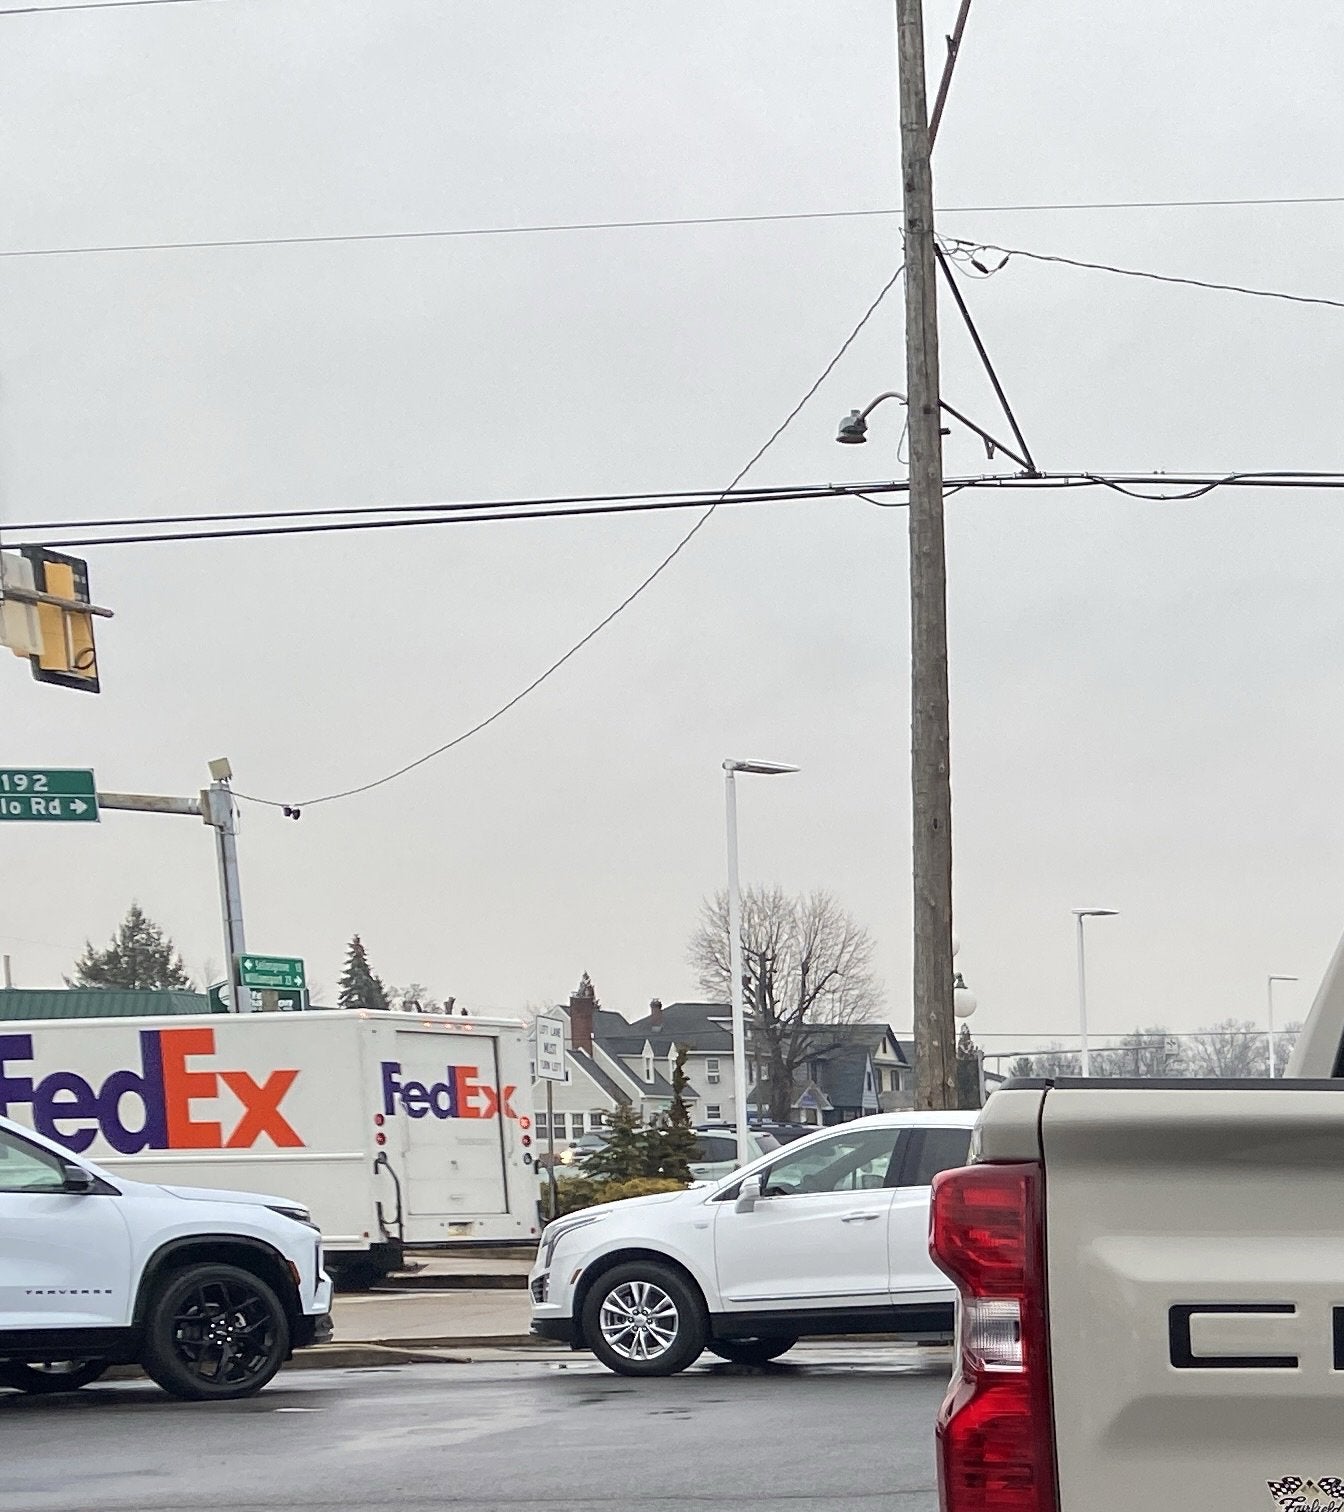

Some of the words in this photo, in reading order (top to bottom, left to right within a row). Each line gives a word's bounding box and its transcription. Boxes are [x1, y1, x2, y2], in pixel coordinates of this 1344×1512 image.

[1, 774, 48, 791] 192
[30, 798, 61, 815] Rd
[380, 1061, 518, 1119] FedEx
